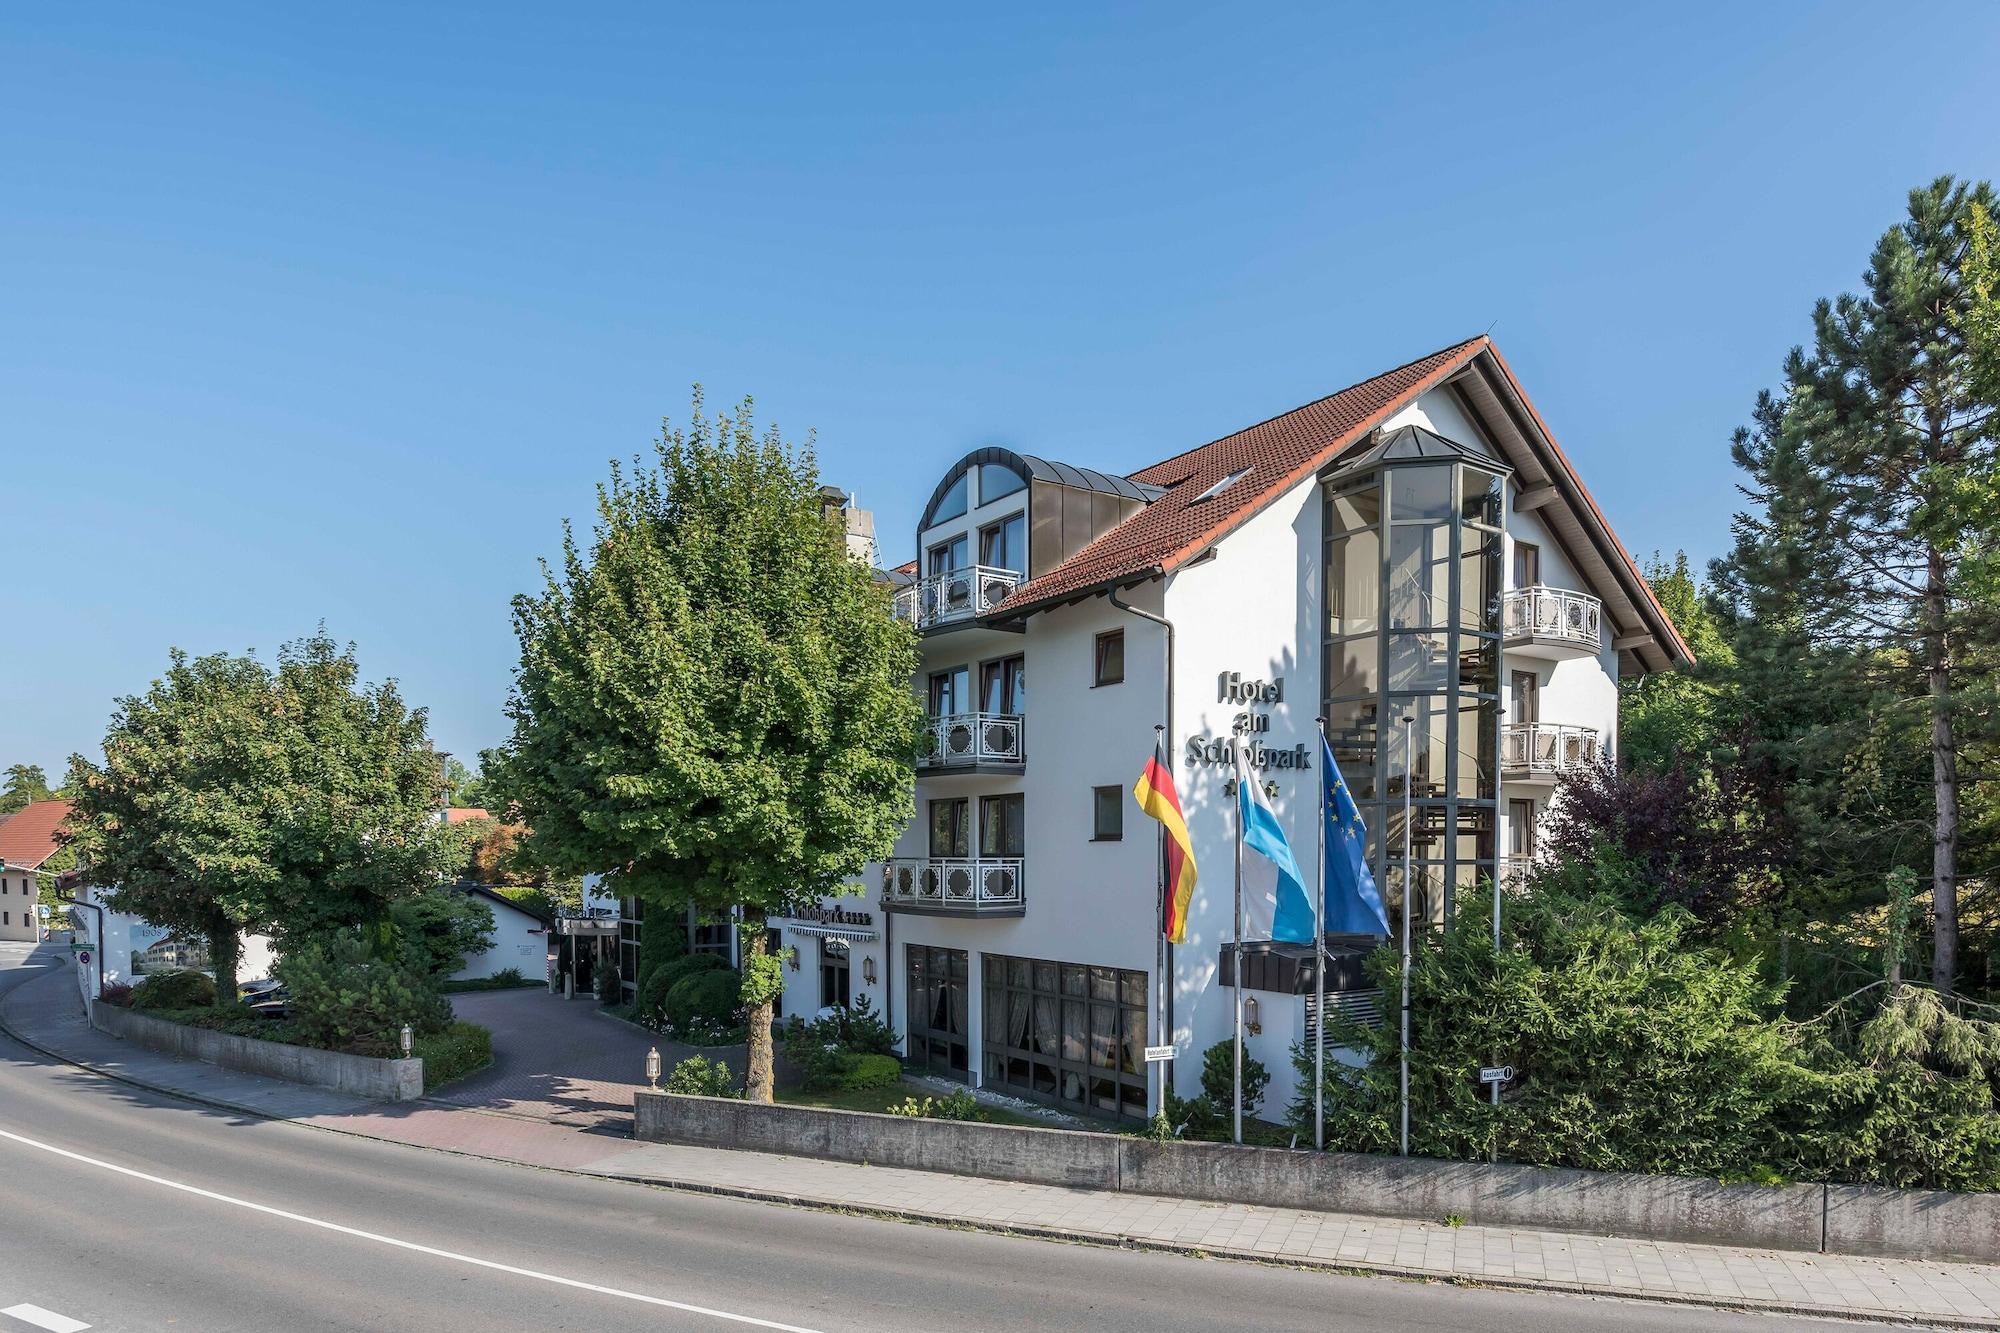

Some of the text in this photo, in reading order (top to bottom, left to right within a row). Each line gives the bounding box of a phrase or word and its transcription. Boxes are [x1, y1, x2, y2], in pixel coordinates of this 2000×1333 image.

[1218, 671, 1284, 704] Hotel
[1233, 711, 1270, 735] am
[795, 903, 840, 924] chloßpark
